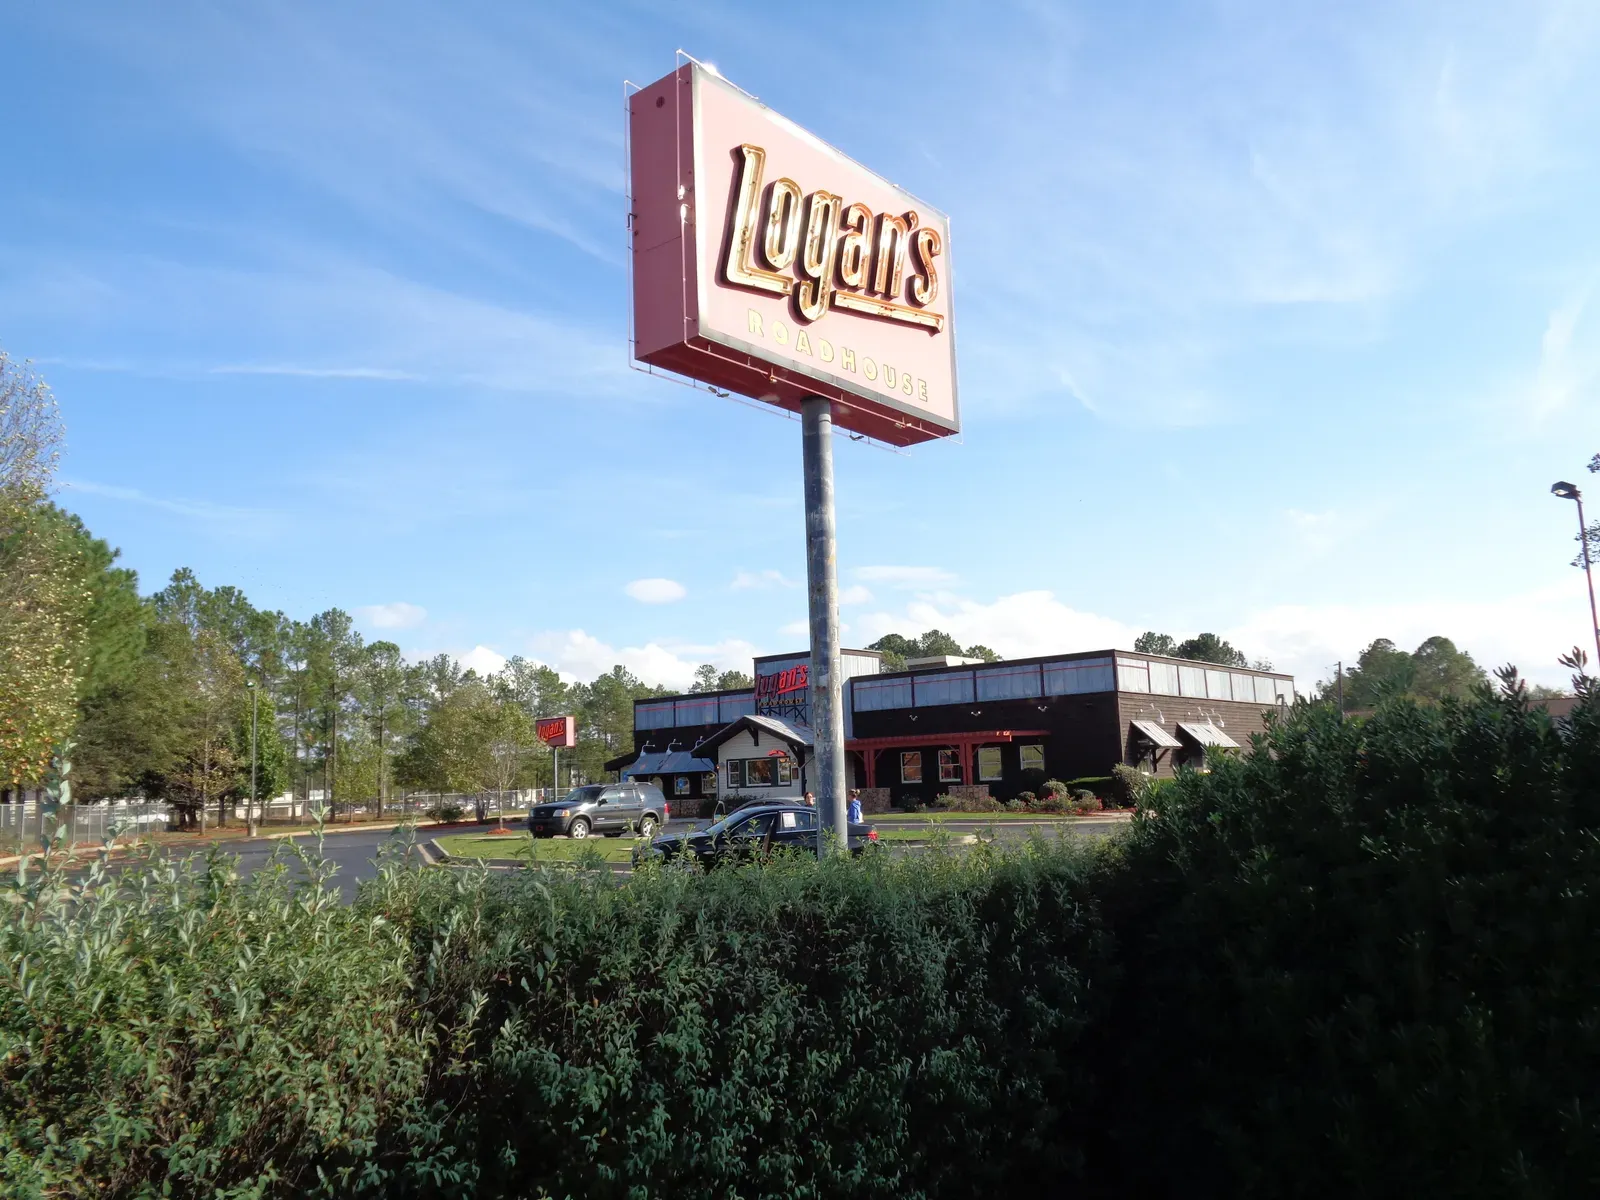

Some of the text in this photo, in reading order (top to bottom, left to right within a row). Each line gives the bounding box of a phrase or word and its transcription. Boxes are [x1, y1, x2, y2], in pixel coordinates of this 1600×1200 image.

[716, 143, 942, 325] Logan's
[748, 308, 928, 402] ROADHOUSE
[755, 664, 808, 699] Logan's
[538, 720, 564, 742] Logan's
